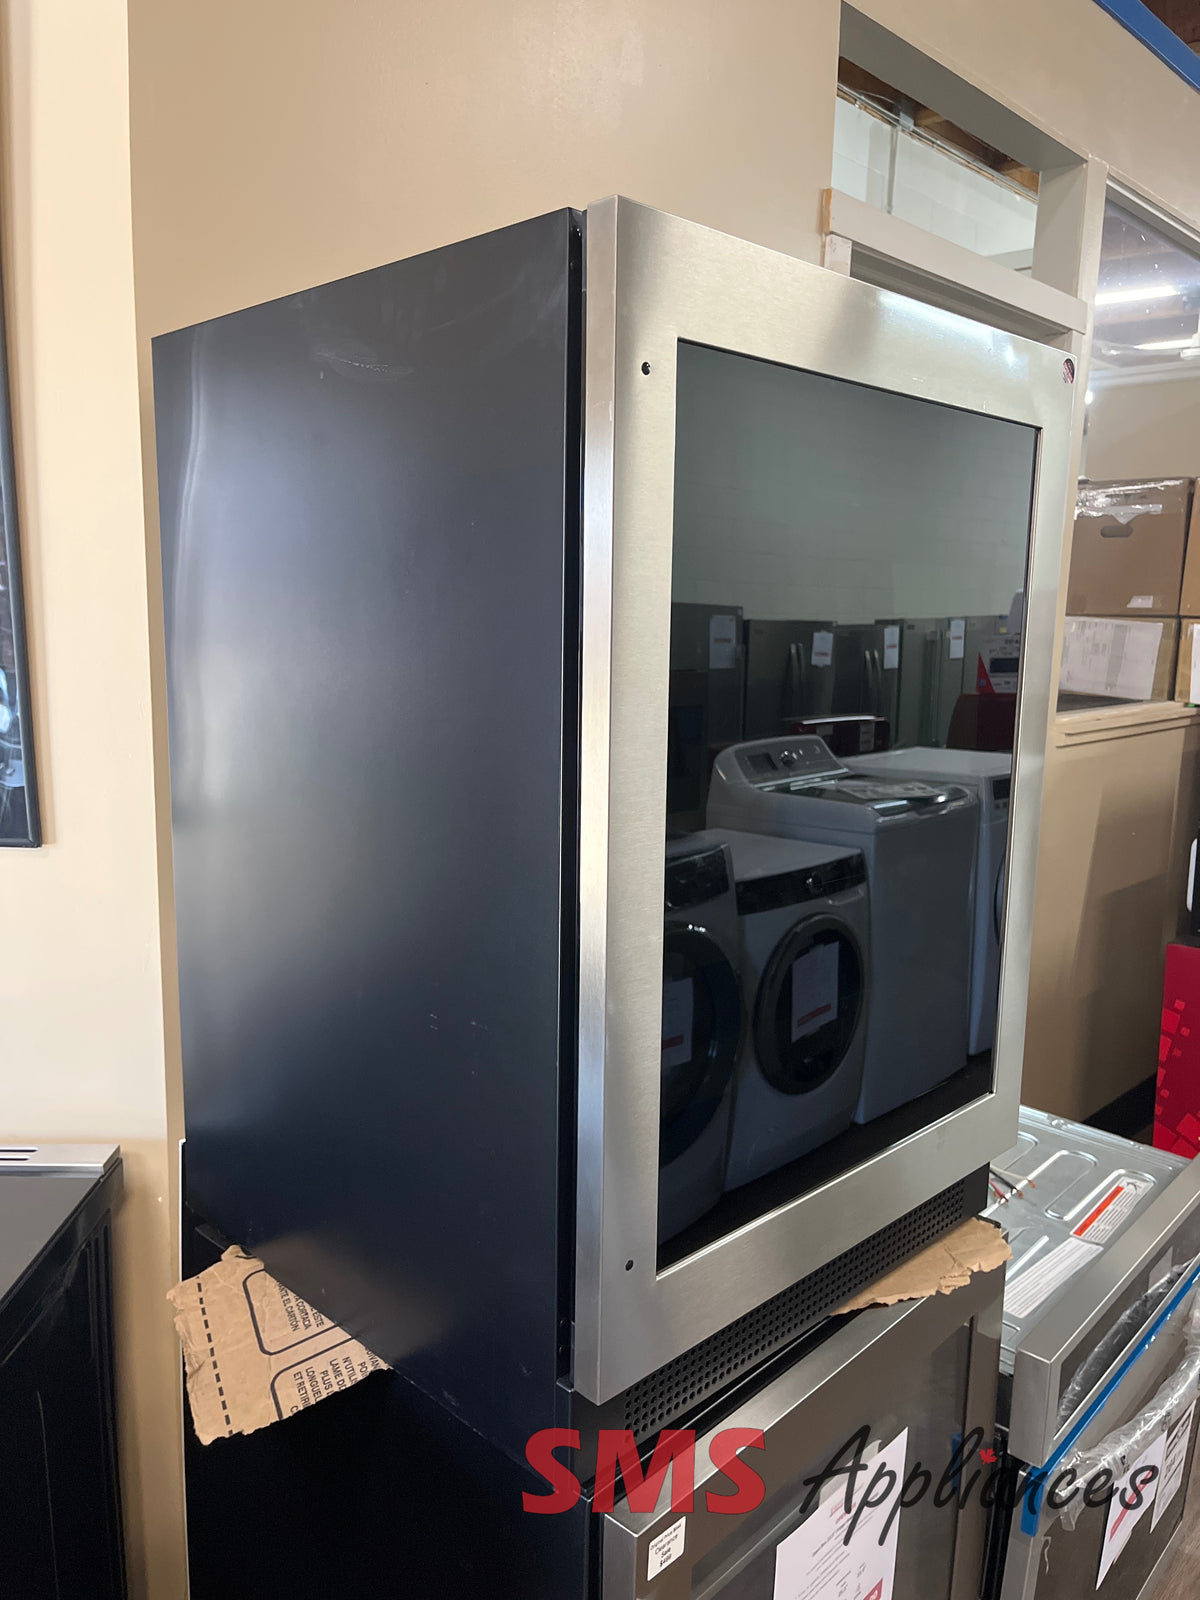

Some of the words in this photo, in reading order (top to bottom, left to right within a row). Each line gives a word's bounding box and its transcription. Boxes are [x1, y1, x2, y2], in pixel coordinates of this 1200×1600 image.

[293, 1371, 304, 1381] ET
[329, 1358, 343, 1380] LAME
[320, 1370, 333, 1391] PLUS
